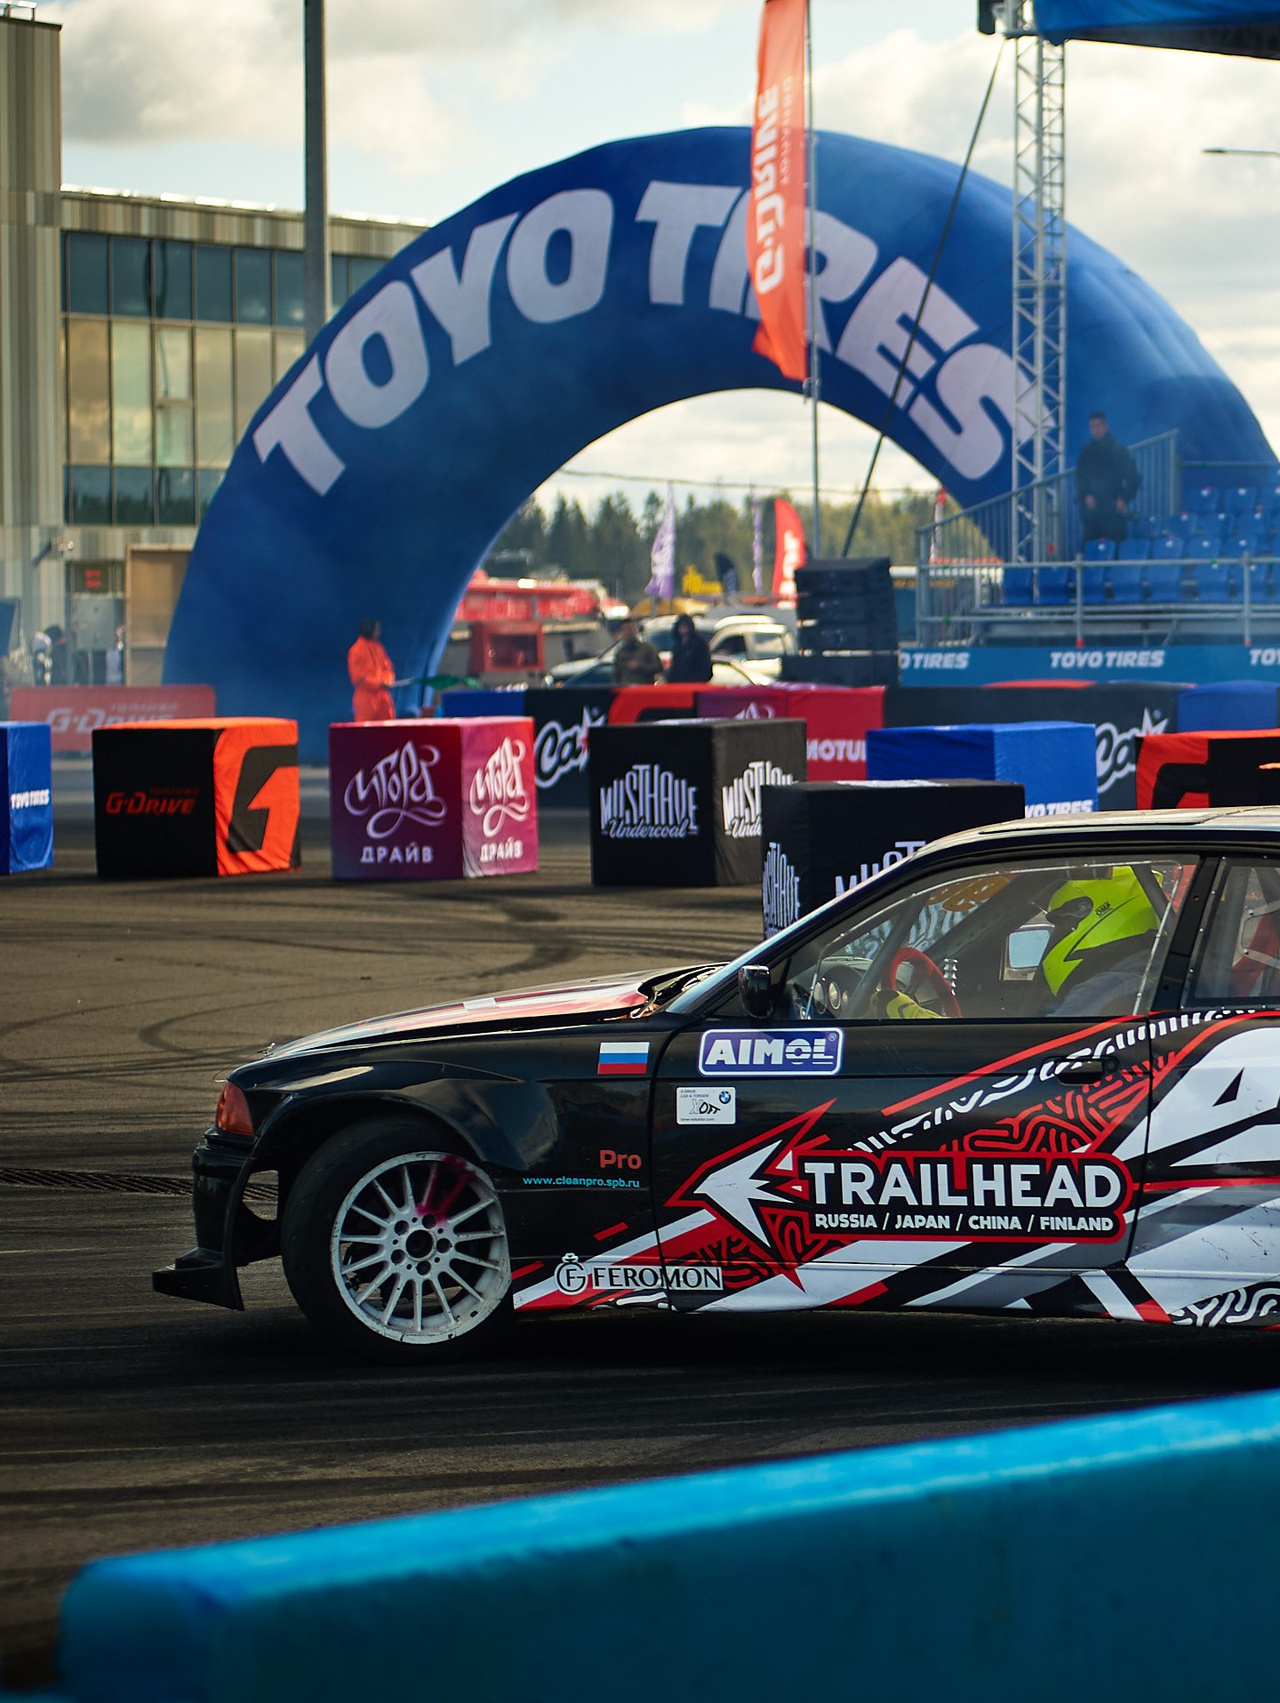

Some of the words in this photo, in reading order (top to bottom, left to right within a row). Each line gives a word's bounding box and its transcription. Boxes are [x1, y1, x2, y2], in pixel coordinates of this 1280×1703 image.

[252, 188, 614, 495] TOYO
[635, 181, 1056, 479] TIRES
[913, 652, 970, 669] TIRES
[1050, 651, 1104, 669] TOYO
[1105, 649, 1165, 668] TIRES
[360, 842, 434, 864] ДРАЙВ
[479, 837, 523, 863] ДРАЙВ
[600, 1150, 642, 1170] Pro
[523, 1176, 640, 1189] www.cleanpro.spb.ru
[804, 1162, 1121, 1208] TRAILHEAD
[815, 1213, 877, 1229] RUSSIA
[895, 1214, 950, 1229] JAPAN
[968, 1214, 1022, 1230] CHINA
[1040, 1216, 1114, 1231] FINLAND
[593, 1267, 721, 1288] FEROMON
